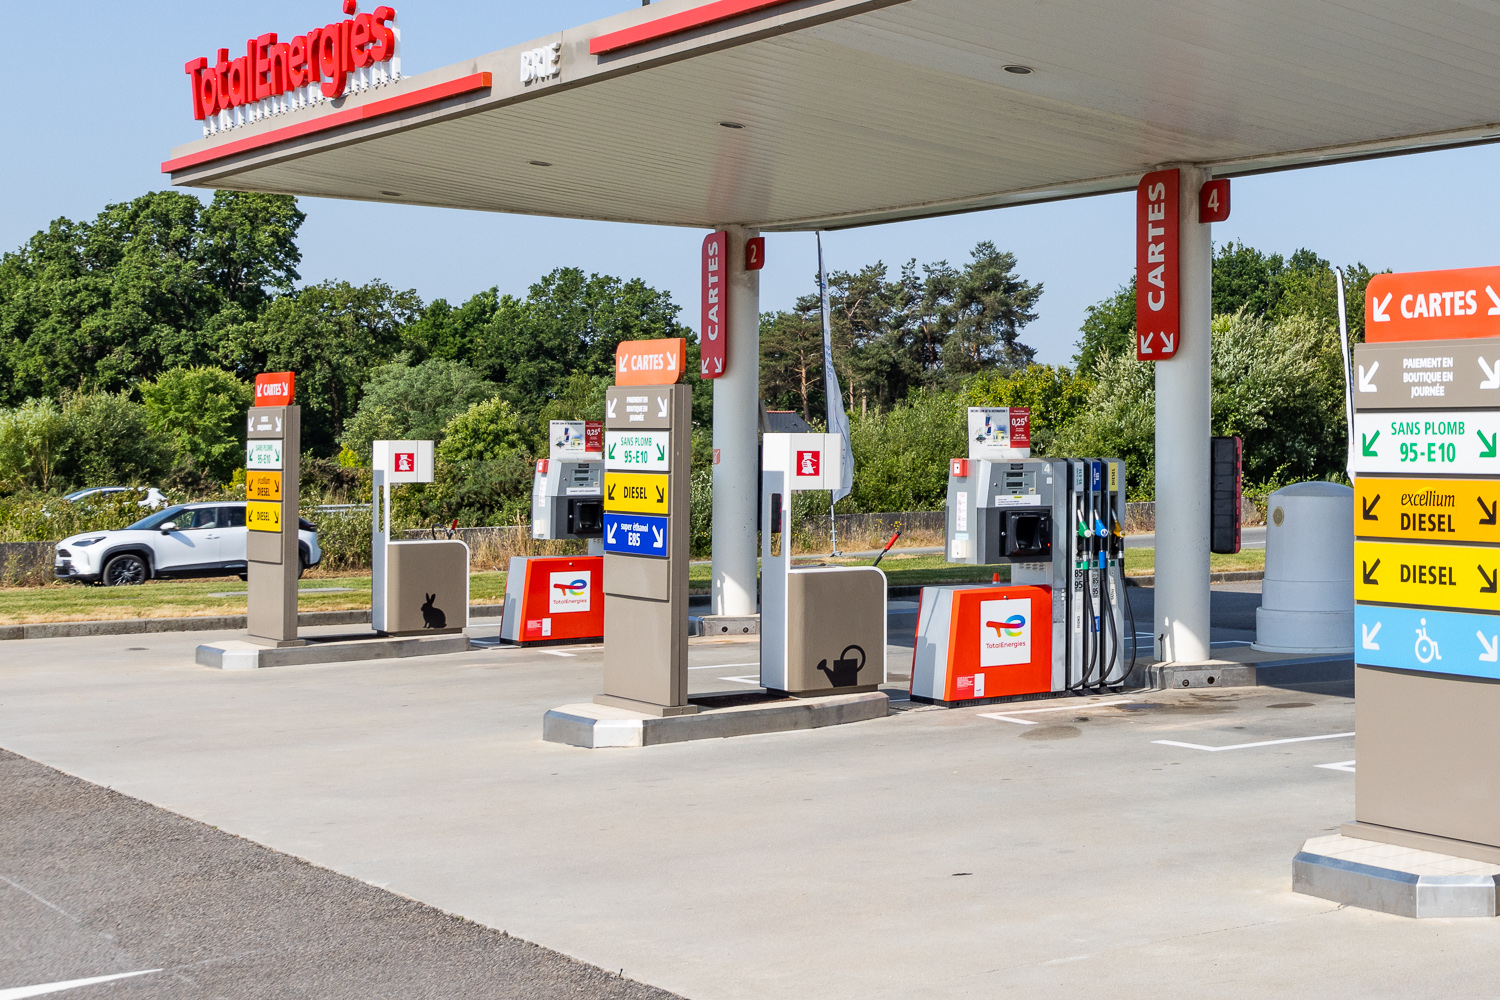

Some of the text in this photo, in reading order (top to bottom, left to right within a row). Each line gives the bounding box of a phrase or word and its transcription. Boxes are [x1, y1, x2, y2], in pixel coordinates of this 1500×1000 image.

[520, 42, 561, 82] BRIE
[1207, 188, 1219, 213] 4
[750, 244, 757, 264] 2
[1147, 182, 1165, 312] CARTES
[708, 241, 719, 341] CARTES
[1400, 289, 1477, 319] CARTES
[631, 354, 664, 370] CARTES
[1402, 357, 1453, 369] PAIEMENT EN
[1402, 371, 1453, 383] BOUTIQUE EN
[263, 383, 281, 396] CARTES
[1410, 383, 1445, 399] JOURNÉE
[1011, 416, 1028, 427] 0,25€
[1391, 421, 1465, 435] SANS PLOMB
[620, 436, 653, 446] SANS PLOMB
[624, 450, 648, 464] 95-E10
[1400, 442, 1456, 463] 95-E10
[1044, 463, 1050, 473] 4
[623, 486, 647, 499] DIESEL
[1401, 490, 1455, 507] excellium
[1400, 512, 1456, 533] DIESEL
[628, 532, 641, 546] E85
[1074, 569, 1083, 578] 85
[1400, 563, 1457, 586] DIESEL
[1074, 580, 1083, 589] 95
[986, 641, 1026, 649] TotalEnergies
